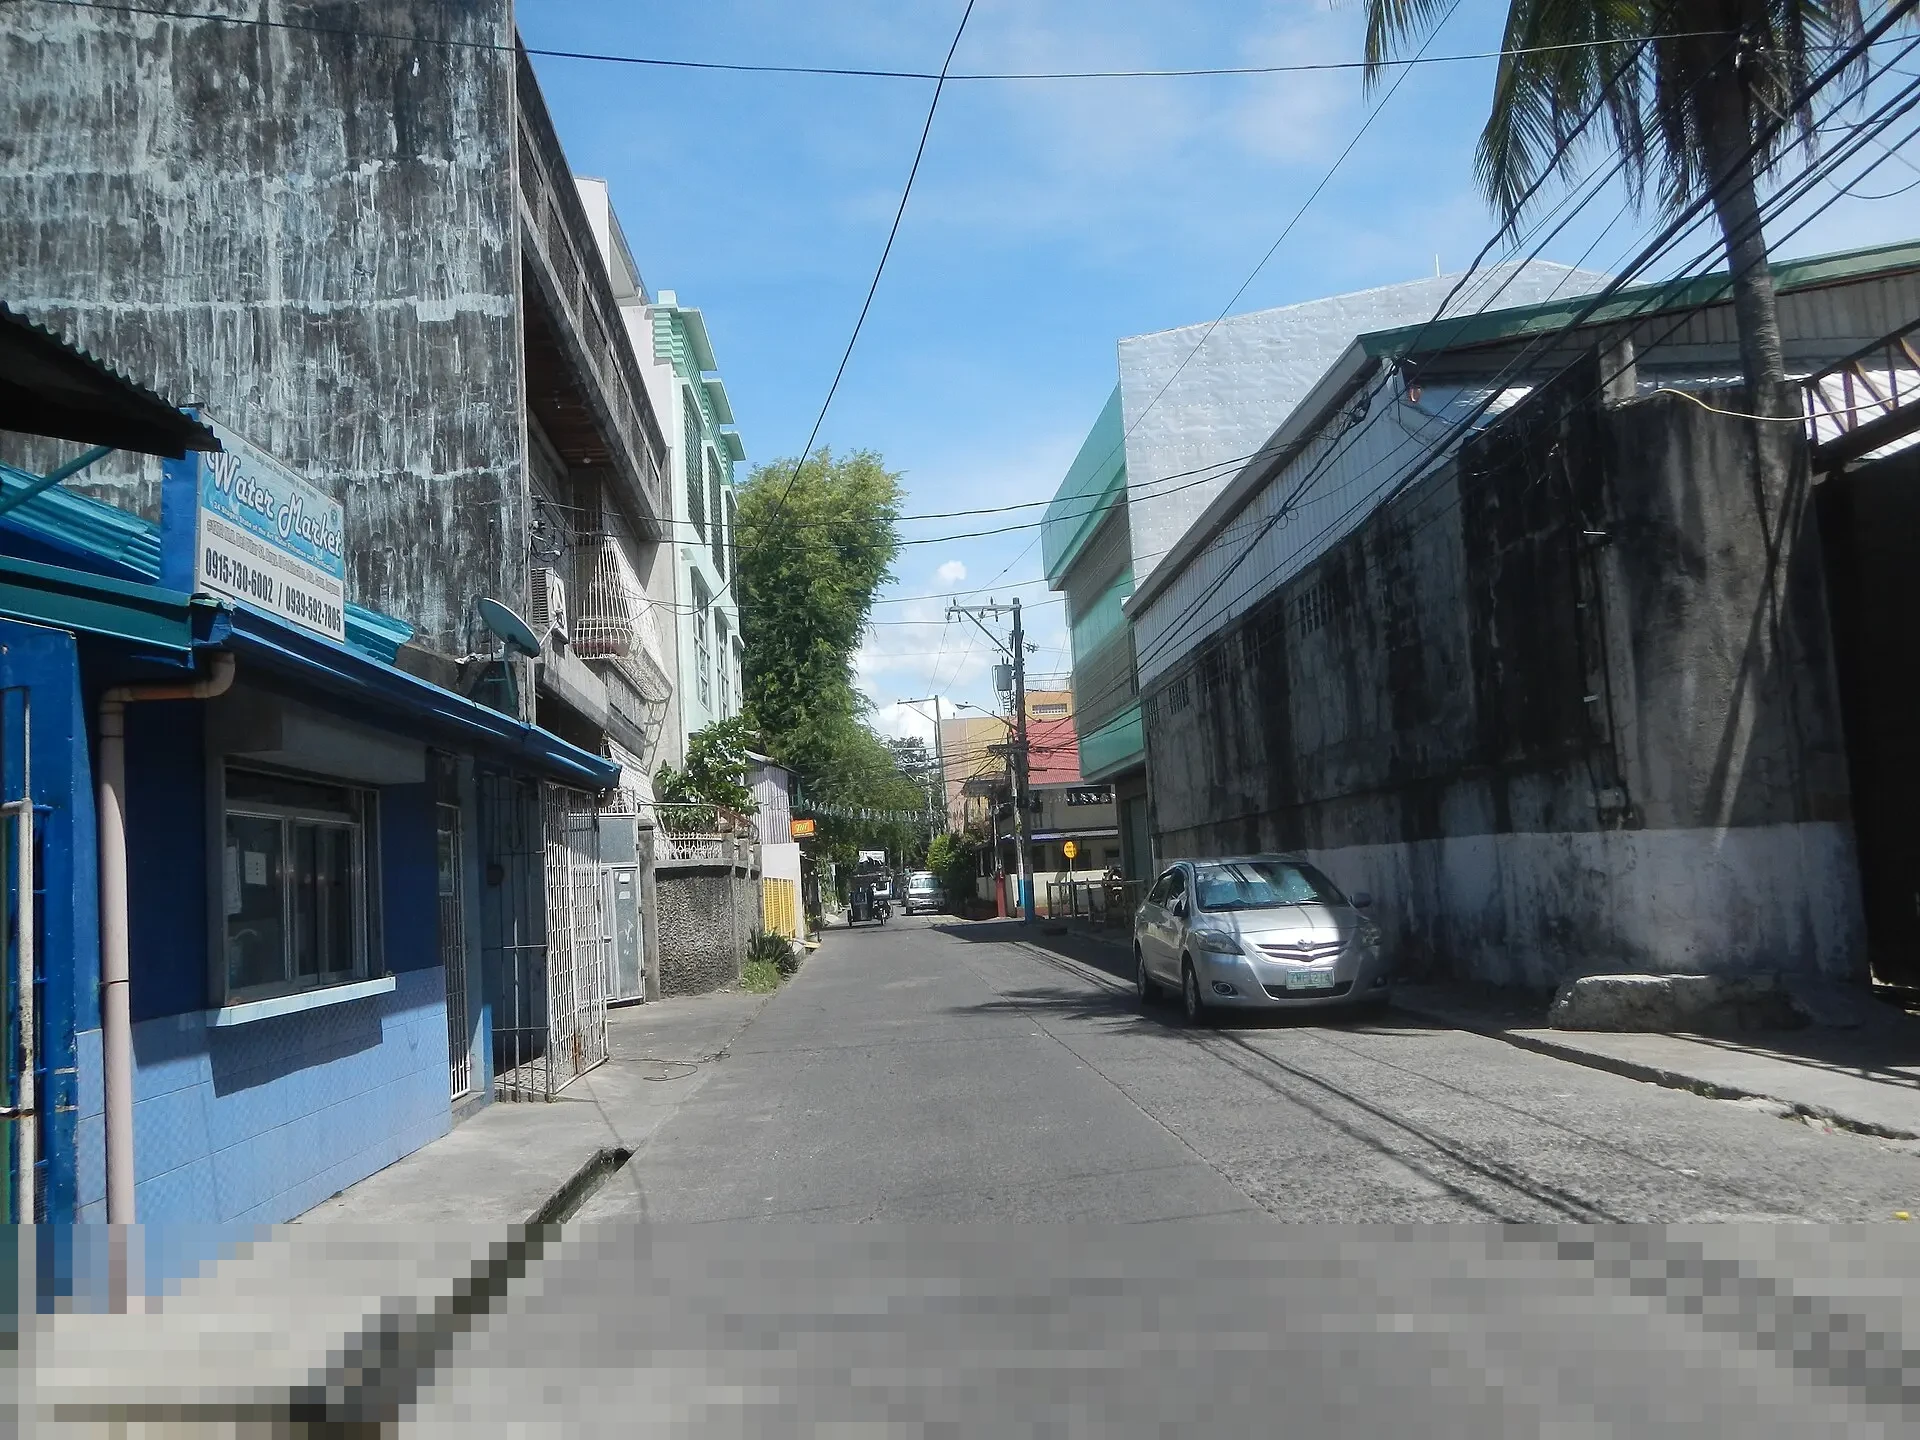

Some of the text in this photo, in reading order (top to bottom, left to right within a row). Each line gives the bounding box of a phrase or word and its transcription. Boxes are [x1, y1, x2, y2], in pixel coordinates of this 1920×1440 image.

[206, 449, 274, 521] Water
[277, 492, 341, 559] Market
[205, 547, 273, 604] 0915-730-6002
[285, 585, 342, 633] 0939-592-7805
